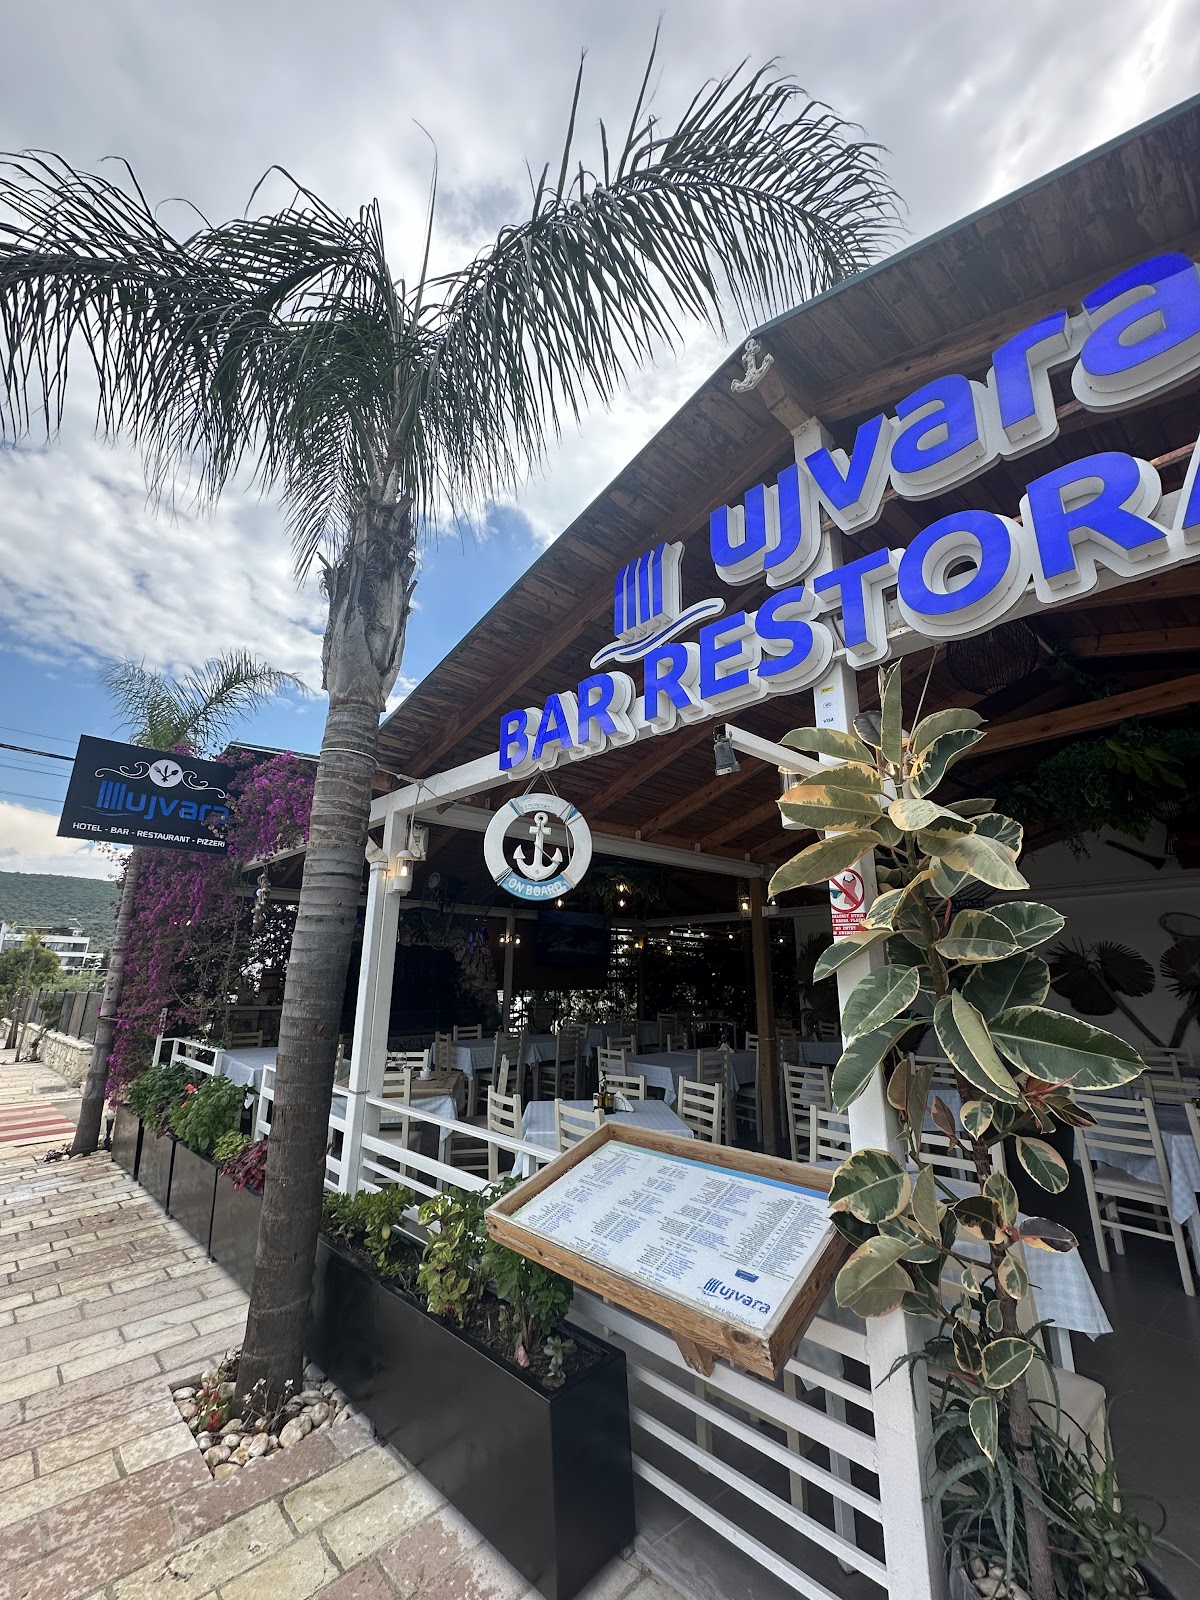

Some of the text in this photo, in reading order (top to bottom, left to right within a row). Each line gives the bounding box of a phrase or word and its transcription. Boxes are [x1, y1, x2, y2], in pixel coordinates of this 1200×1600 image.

[709, 252, 1200, 578] ujvara
[499, 671, 630, 773] BAR
[72, 822, 102, 832] HOTEL
[110, 826, 129, 836] BAR
[137, 831, 190, 844] RESTAURANT
[508, 878, 563, 897] ON BOARD
[720, 1286, 771, 1314] ujvara
